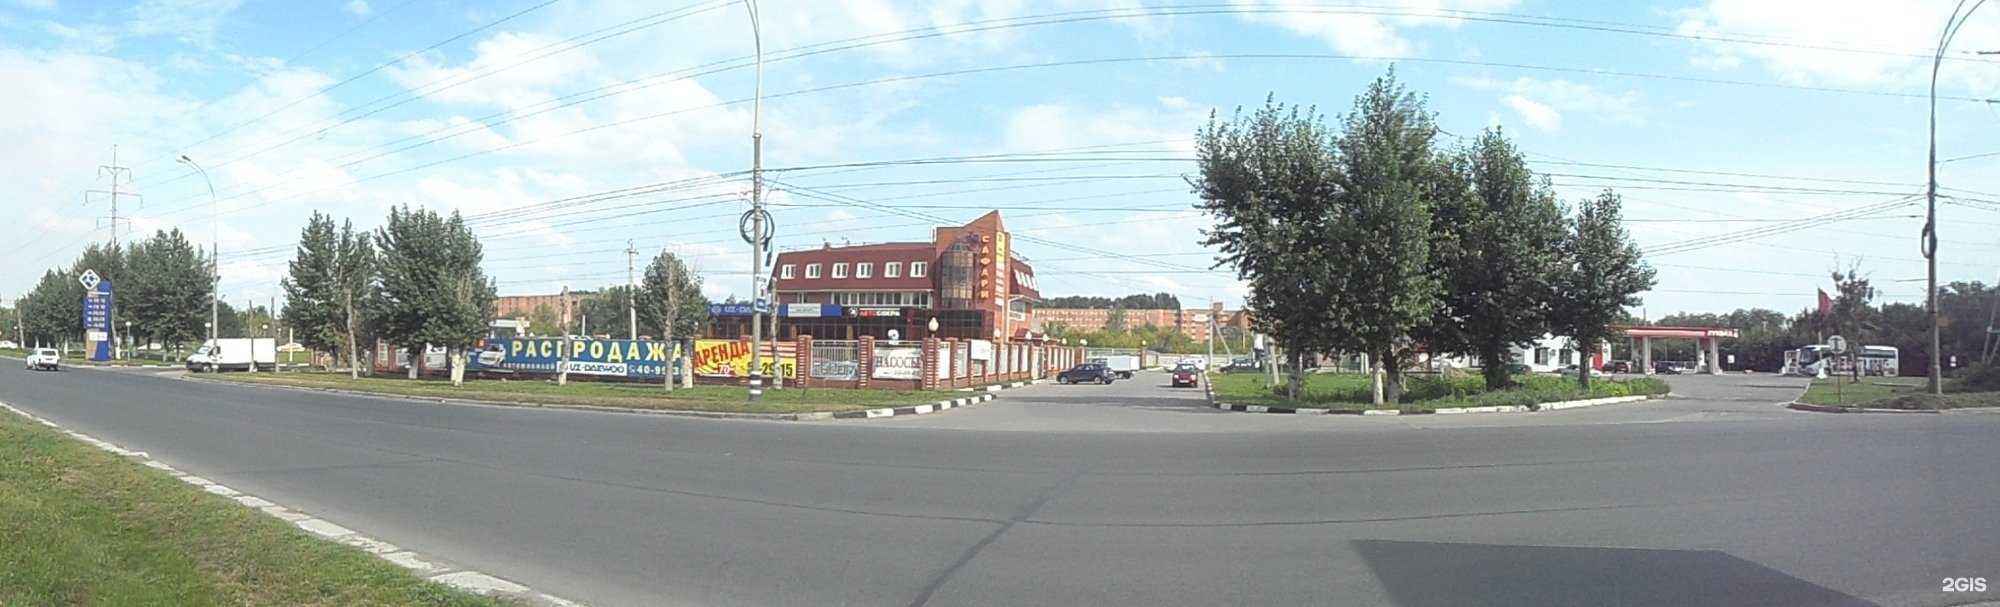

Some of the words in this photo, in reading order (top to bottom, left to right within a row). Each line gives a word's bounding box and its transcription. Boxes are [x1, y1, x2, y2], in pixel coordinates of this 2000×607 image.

[981, 235, 991, 298] САФАРИ
[695, 341, 749, 368] АРЕНДА
[875, 355, 921, 368] НАСОСЫ
